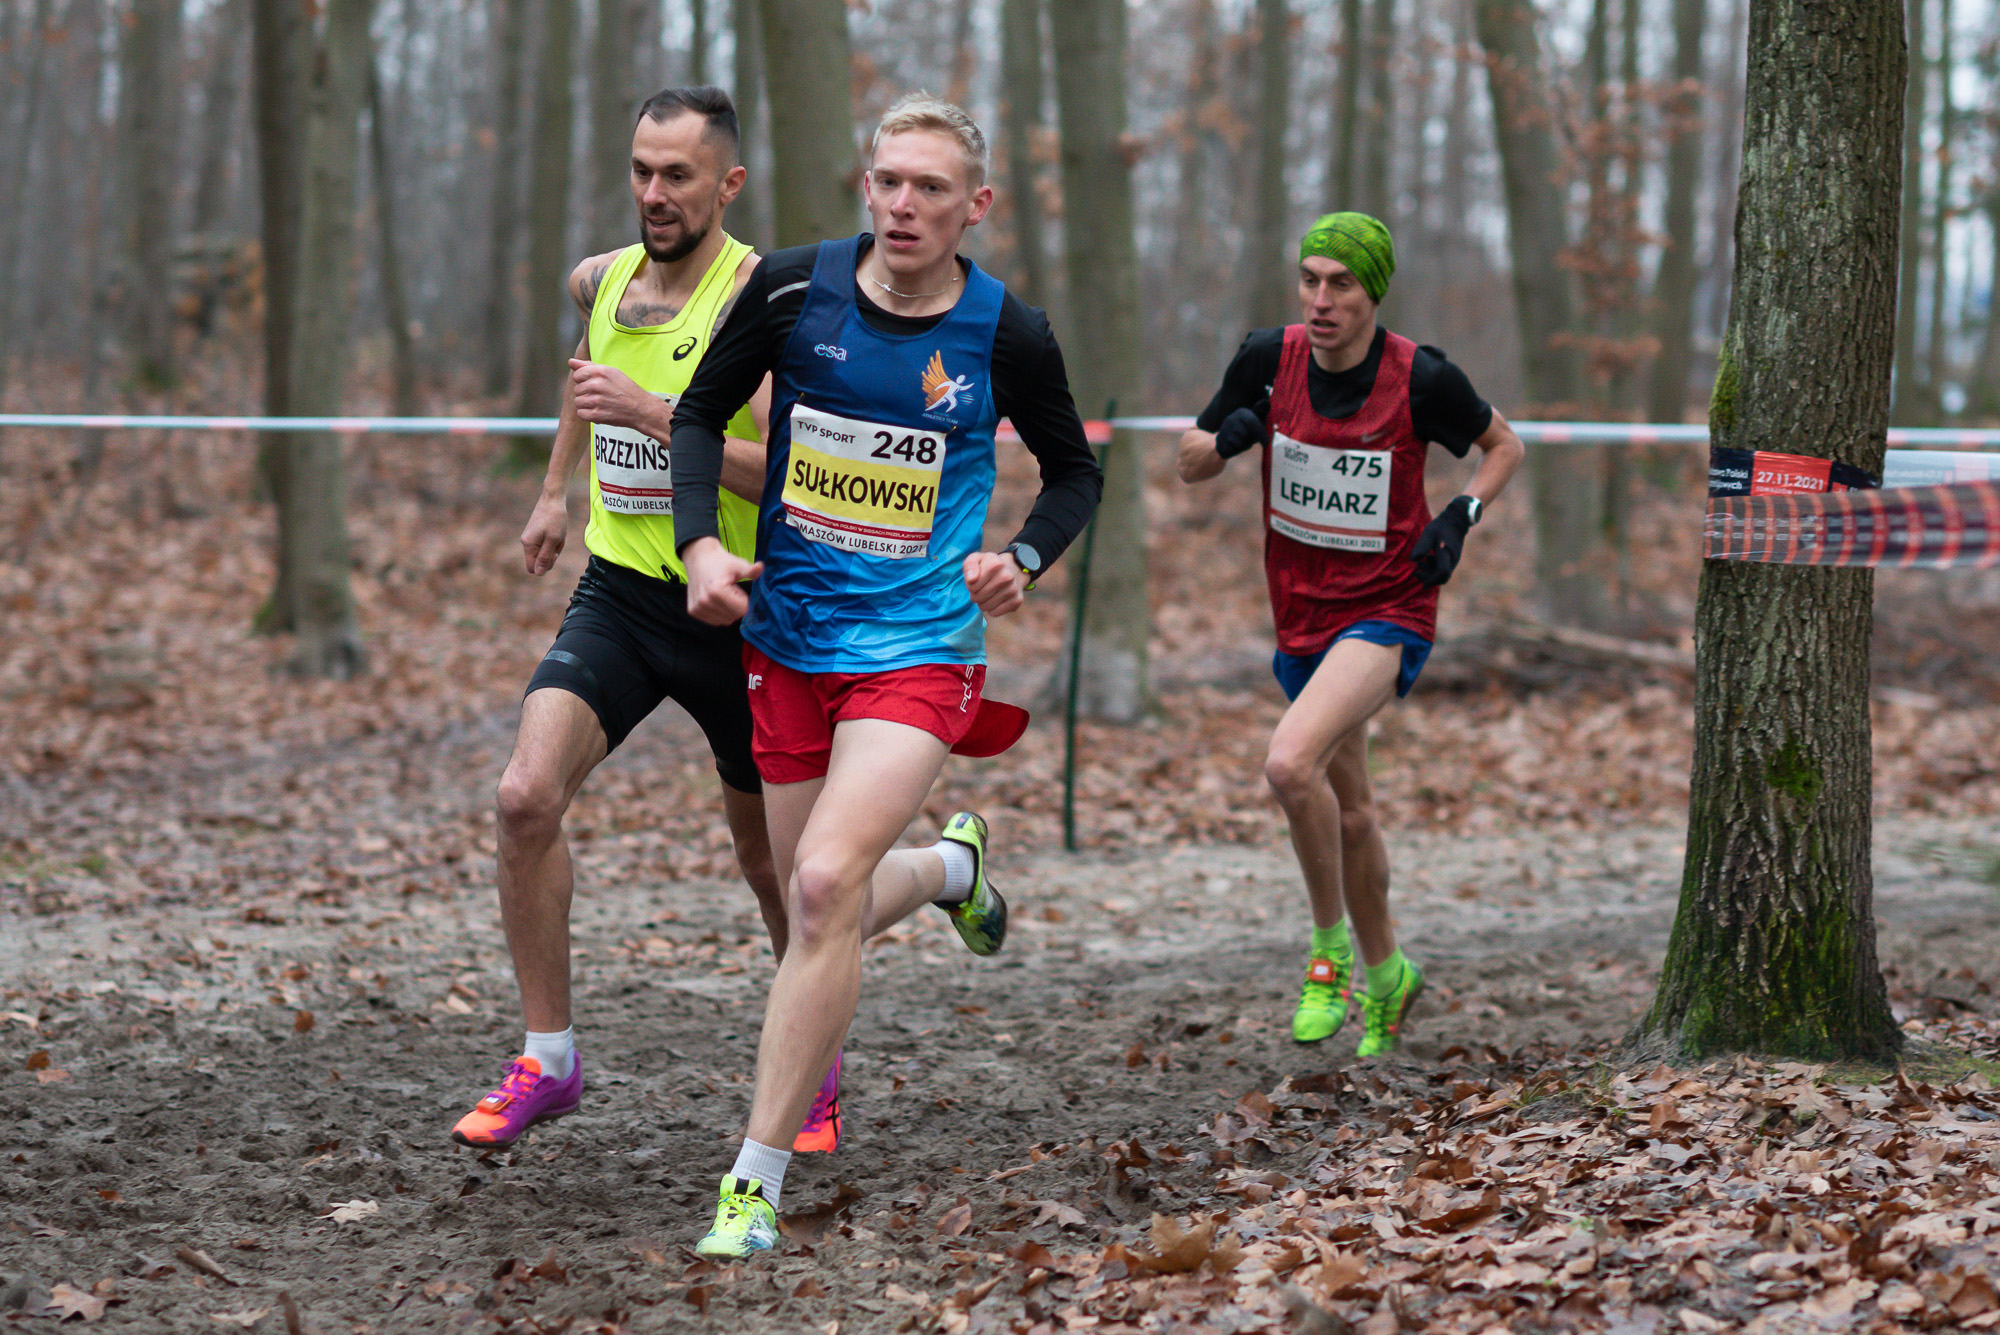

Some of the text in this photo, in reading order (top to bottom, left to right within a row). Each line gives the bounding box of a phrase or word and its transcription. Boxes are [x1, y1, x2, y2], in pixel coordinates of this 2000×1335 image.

[797, 420, 856, 444] TVP SPORT
[595, 433, 669, 471] BRZEZIŃS
[870, 431, 938, 464] 248
[1331, 455, 1383, 478] 475
[1756, 471, 1824, 491] 27.11.2021
[792, 459, 935, 513] SUŁKOWSKI
[1281, 477, 1379, 515] LEPIARZ
[849, 536, 897, 554] LUBELSKI
[899, 544, 923, 554] 2021
[1275, 519, 1381, 548] TOMASZÓW LUBELSKI 2021
